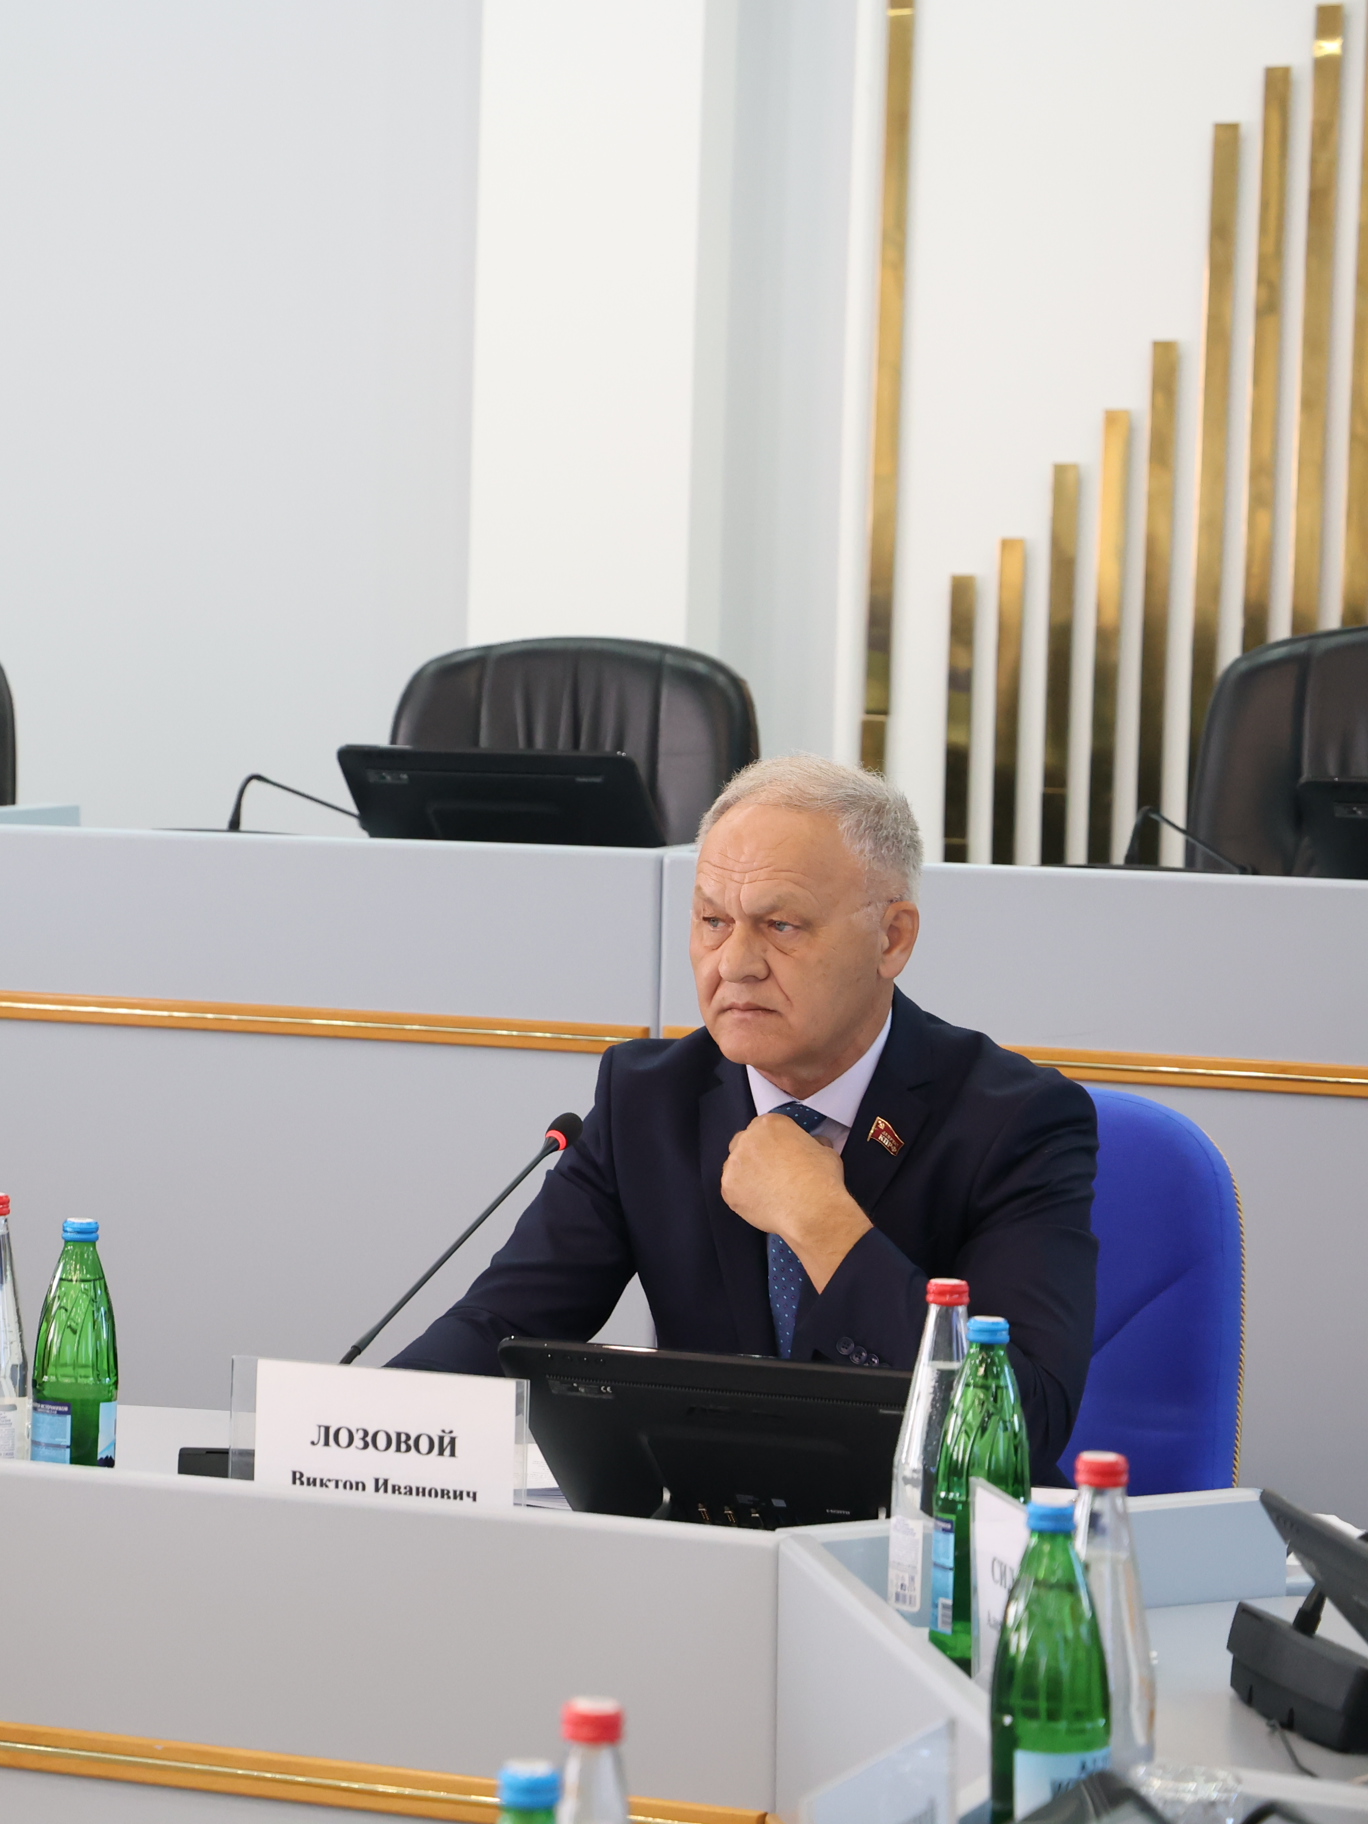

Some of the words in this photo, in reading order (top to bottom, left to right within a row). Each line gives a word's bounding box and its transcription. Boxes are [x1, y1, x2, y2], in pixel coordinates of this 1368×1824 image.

[878, 1133, 897, 1152] КПРФ
[310, 1424, 458, 1458] ЛОЗОВОЙ
[373, 1477, 478, 1503] Иванович
